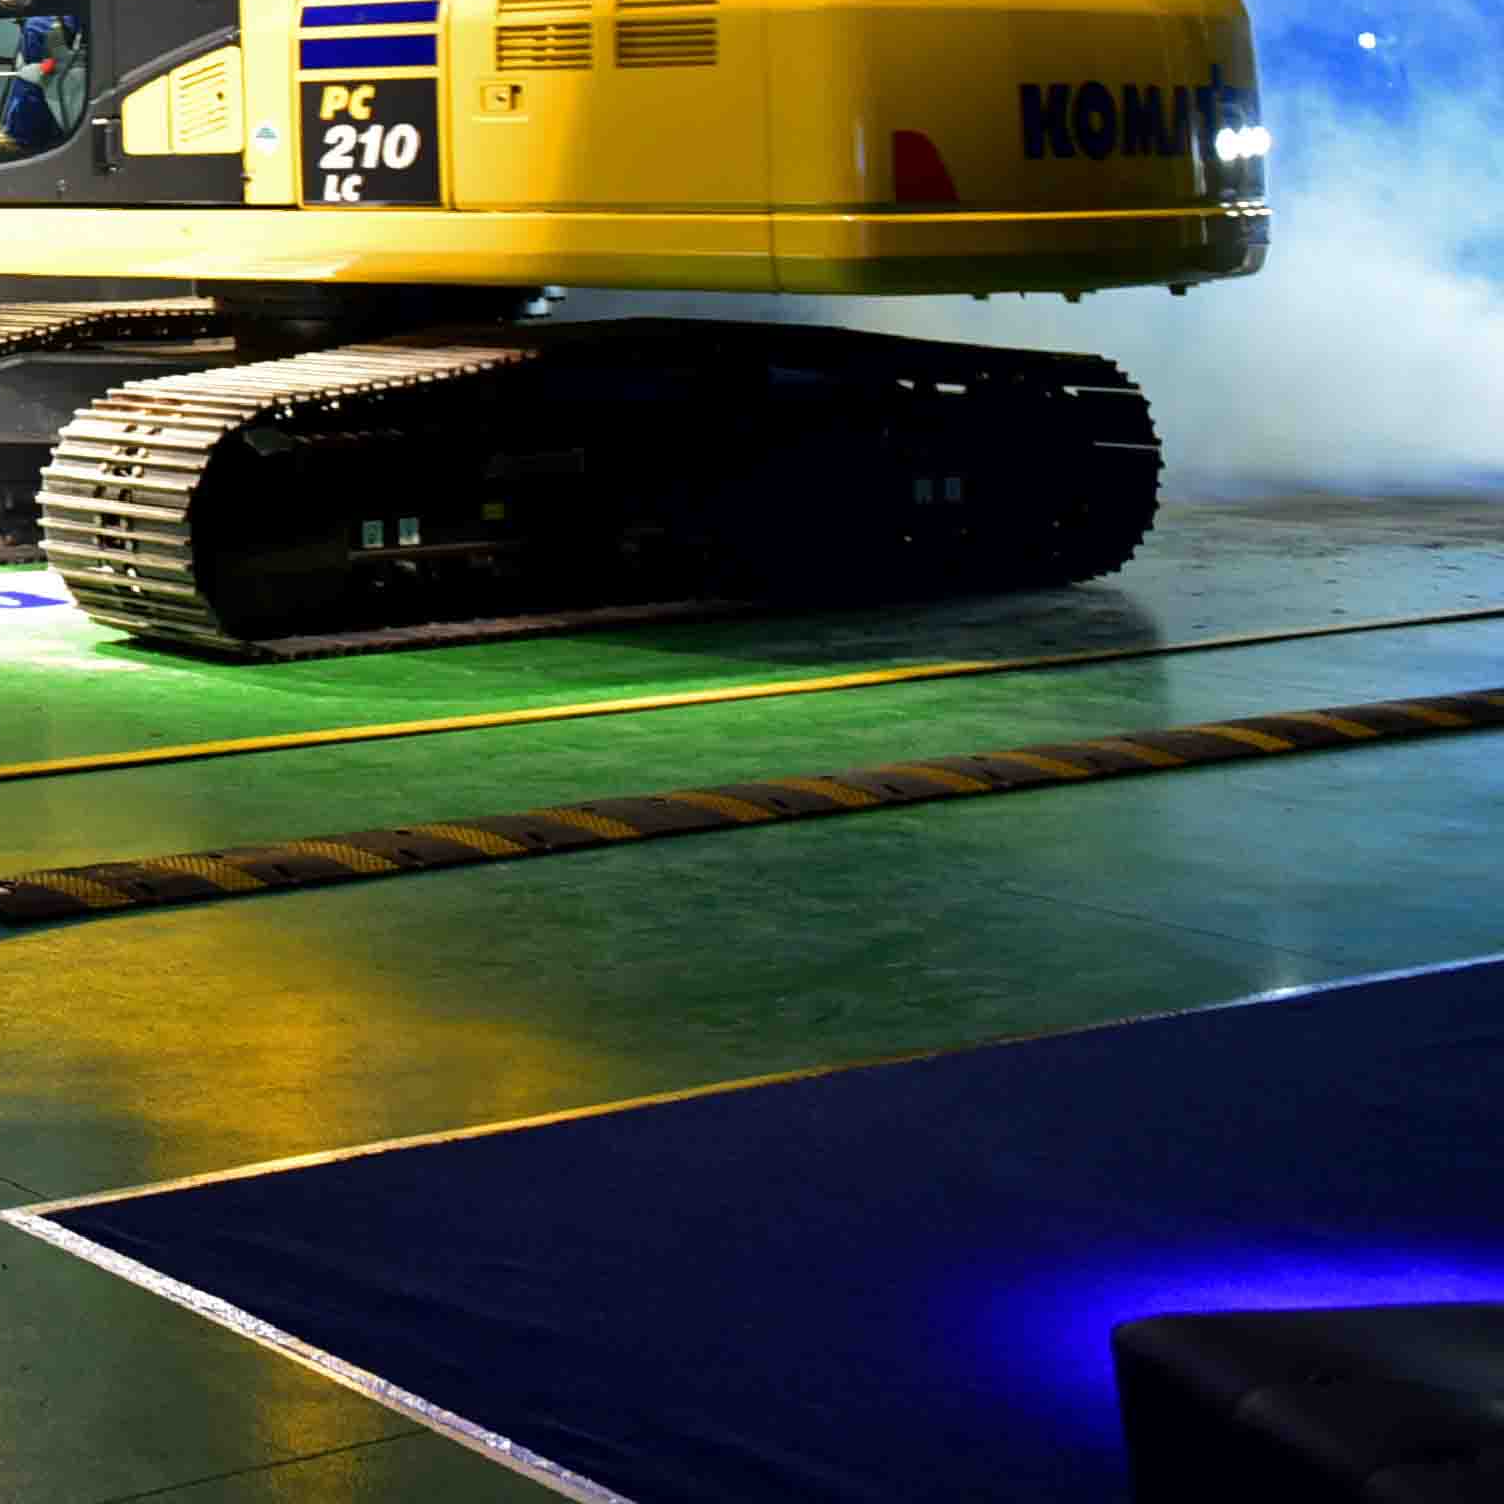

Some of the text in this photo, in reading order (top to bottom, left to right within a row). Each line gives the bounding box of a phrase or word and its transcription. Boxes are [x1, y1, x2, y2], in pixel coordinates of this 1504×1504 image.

[319, 83, 377, 121] PC
[1019, 63, 1260, 161] KOMAT
[318, 123, 422, 170] 210
[323, 173, 364, 202] LC
